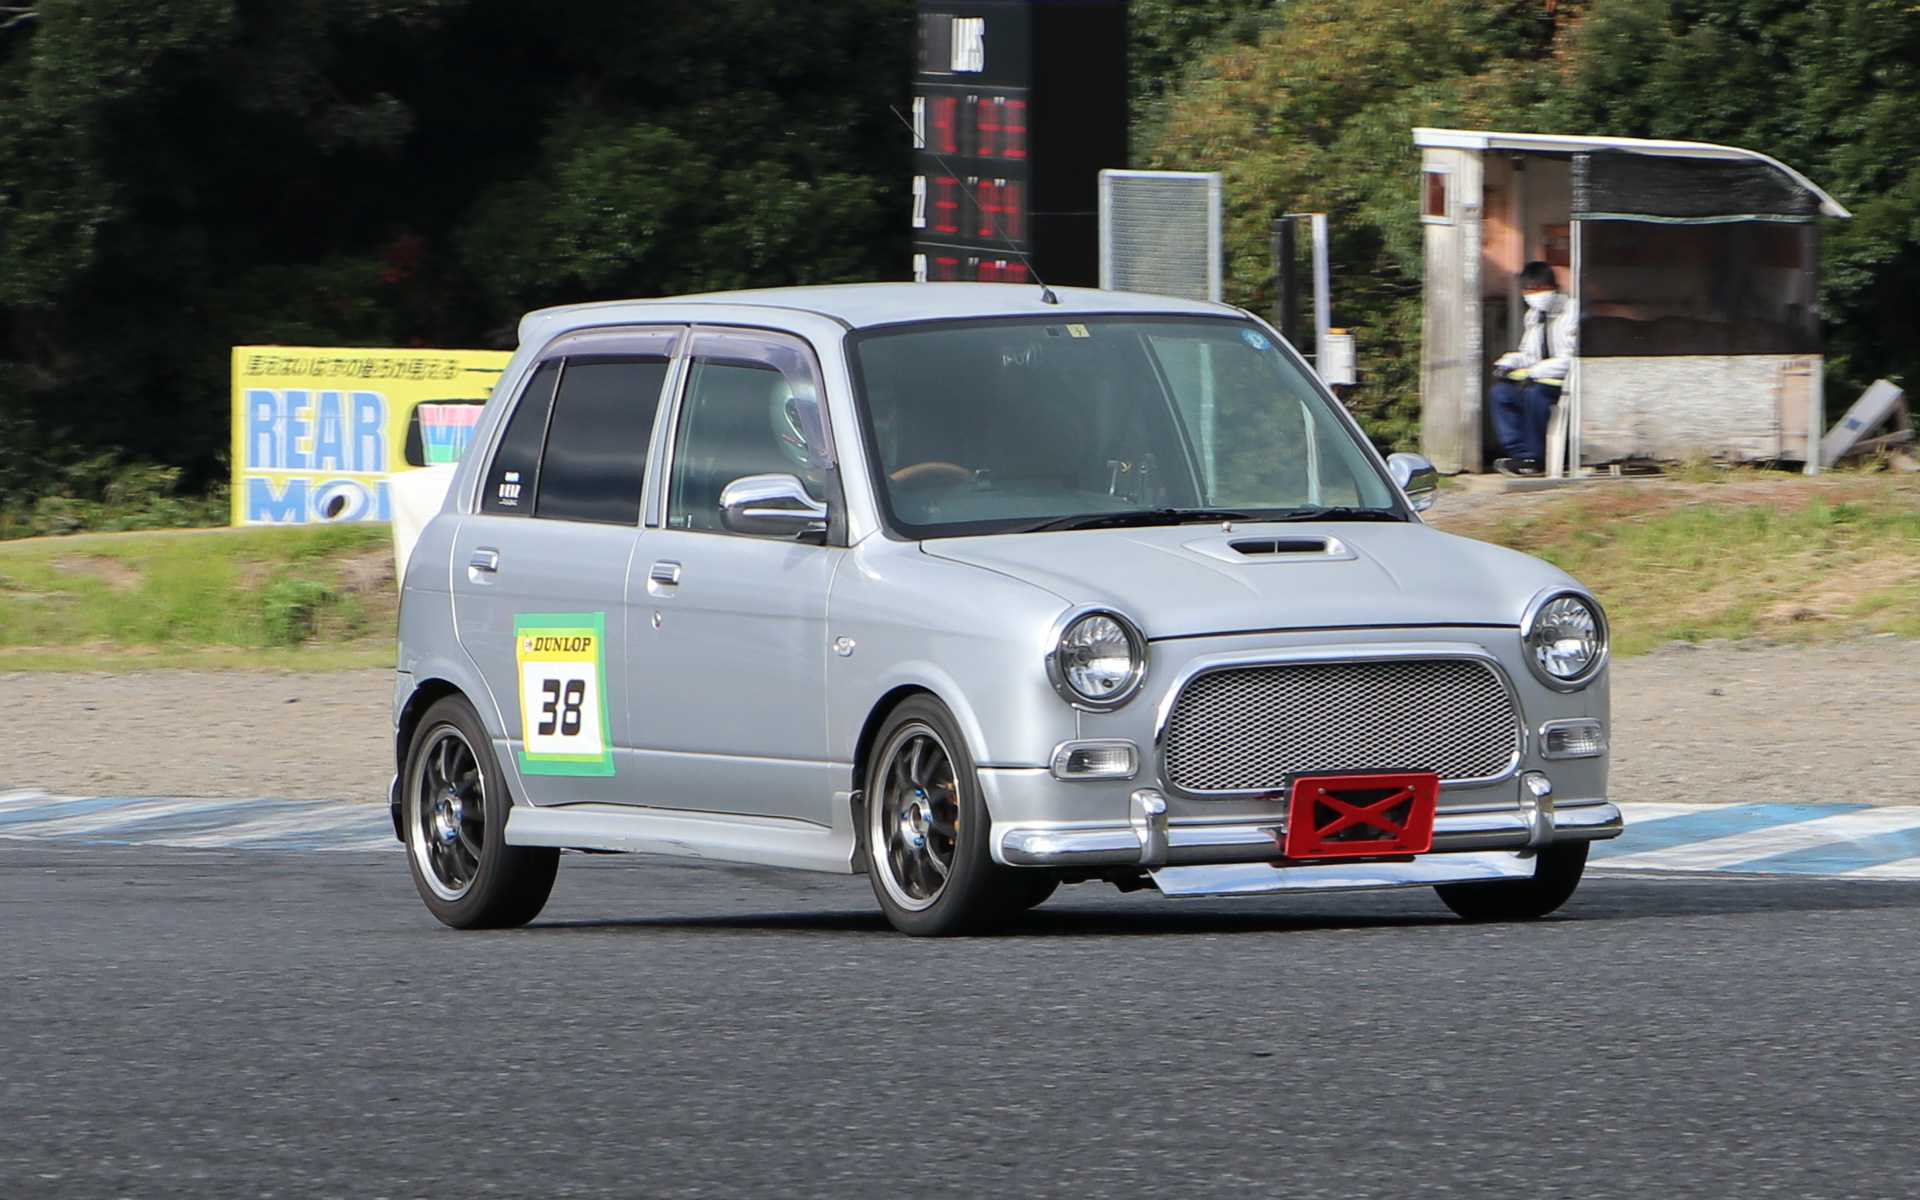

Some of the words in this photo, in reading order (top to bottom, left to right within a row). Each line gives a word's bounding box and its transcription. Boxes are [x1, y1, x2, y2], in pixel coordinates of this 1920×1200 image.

[245, 389, 388, 472] REAR
[533, 636, 592, 652] DUNLOP
[538, 678, 586, 736] 38
